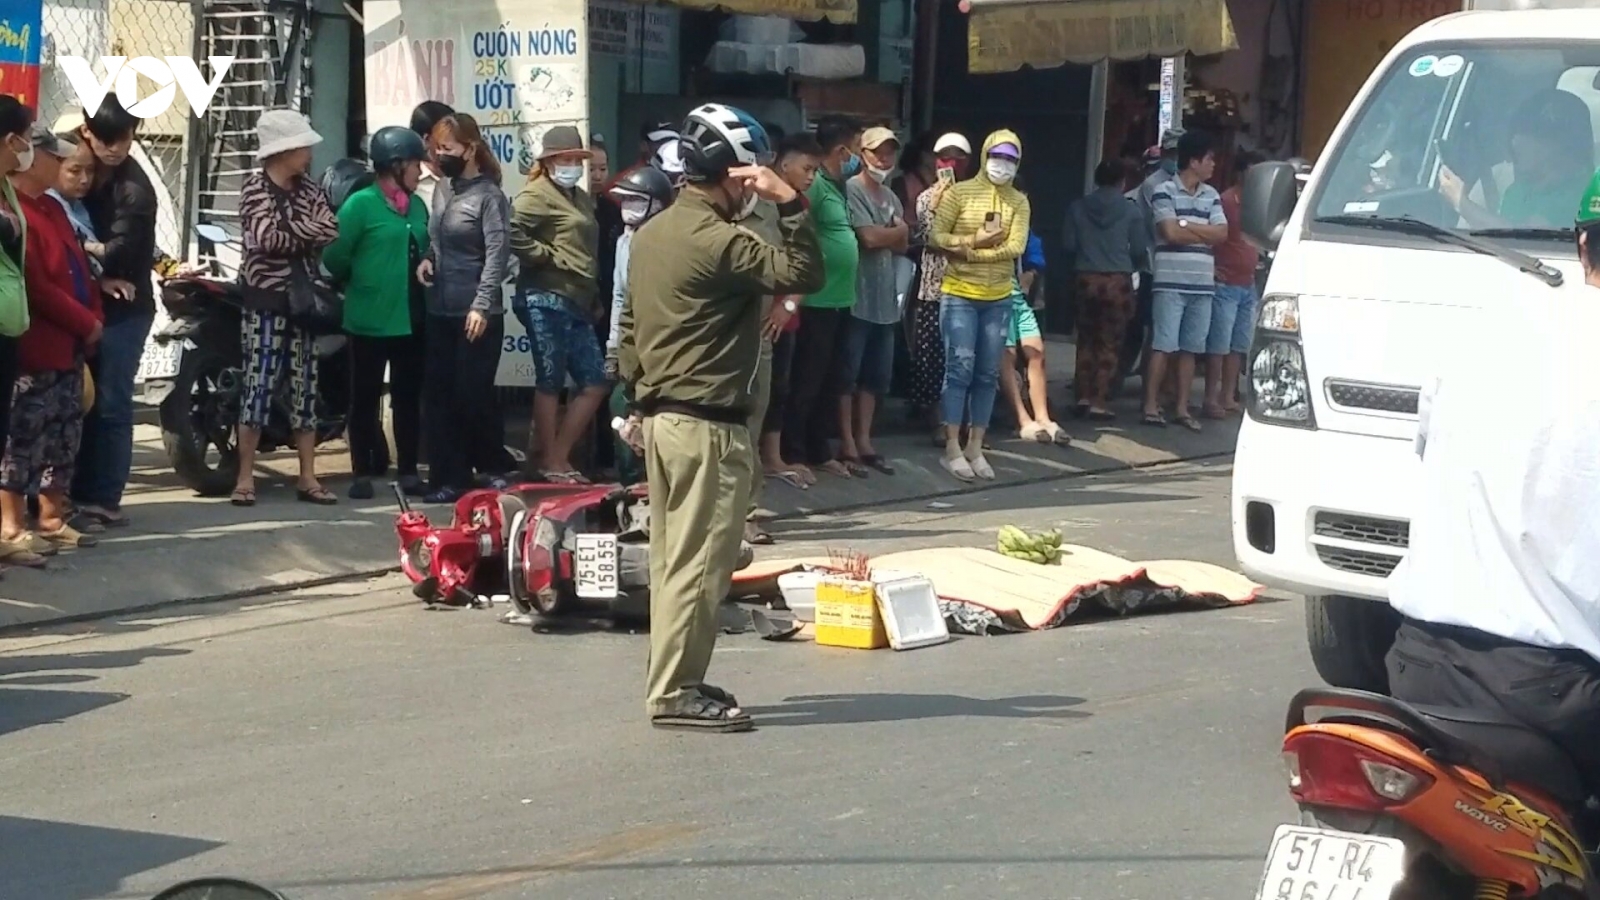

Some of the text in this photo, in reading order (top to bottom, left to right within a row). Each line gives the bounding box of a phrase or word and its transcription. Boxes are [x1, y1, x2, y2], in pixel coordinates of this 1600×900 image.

[473, 22, 577, 58] CUỐN NÓNG
[372, 19, 455, 106] BÁNH
[474, 76, 517, 110] ƯỚT
[598, 540, 615, 592] 158.55
